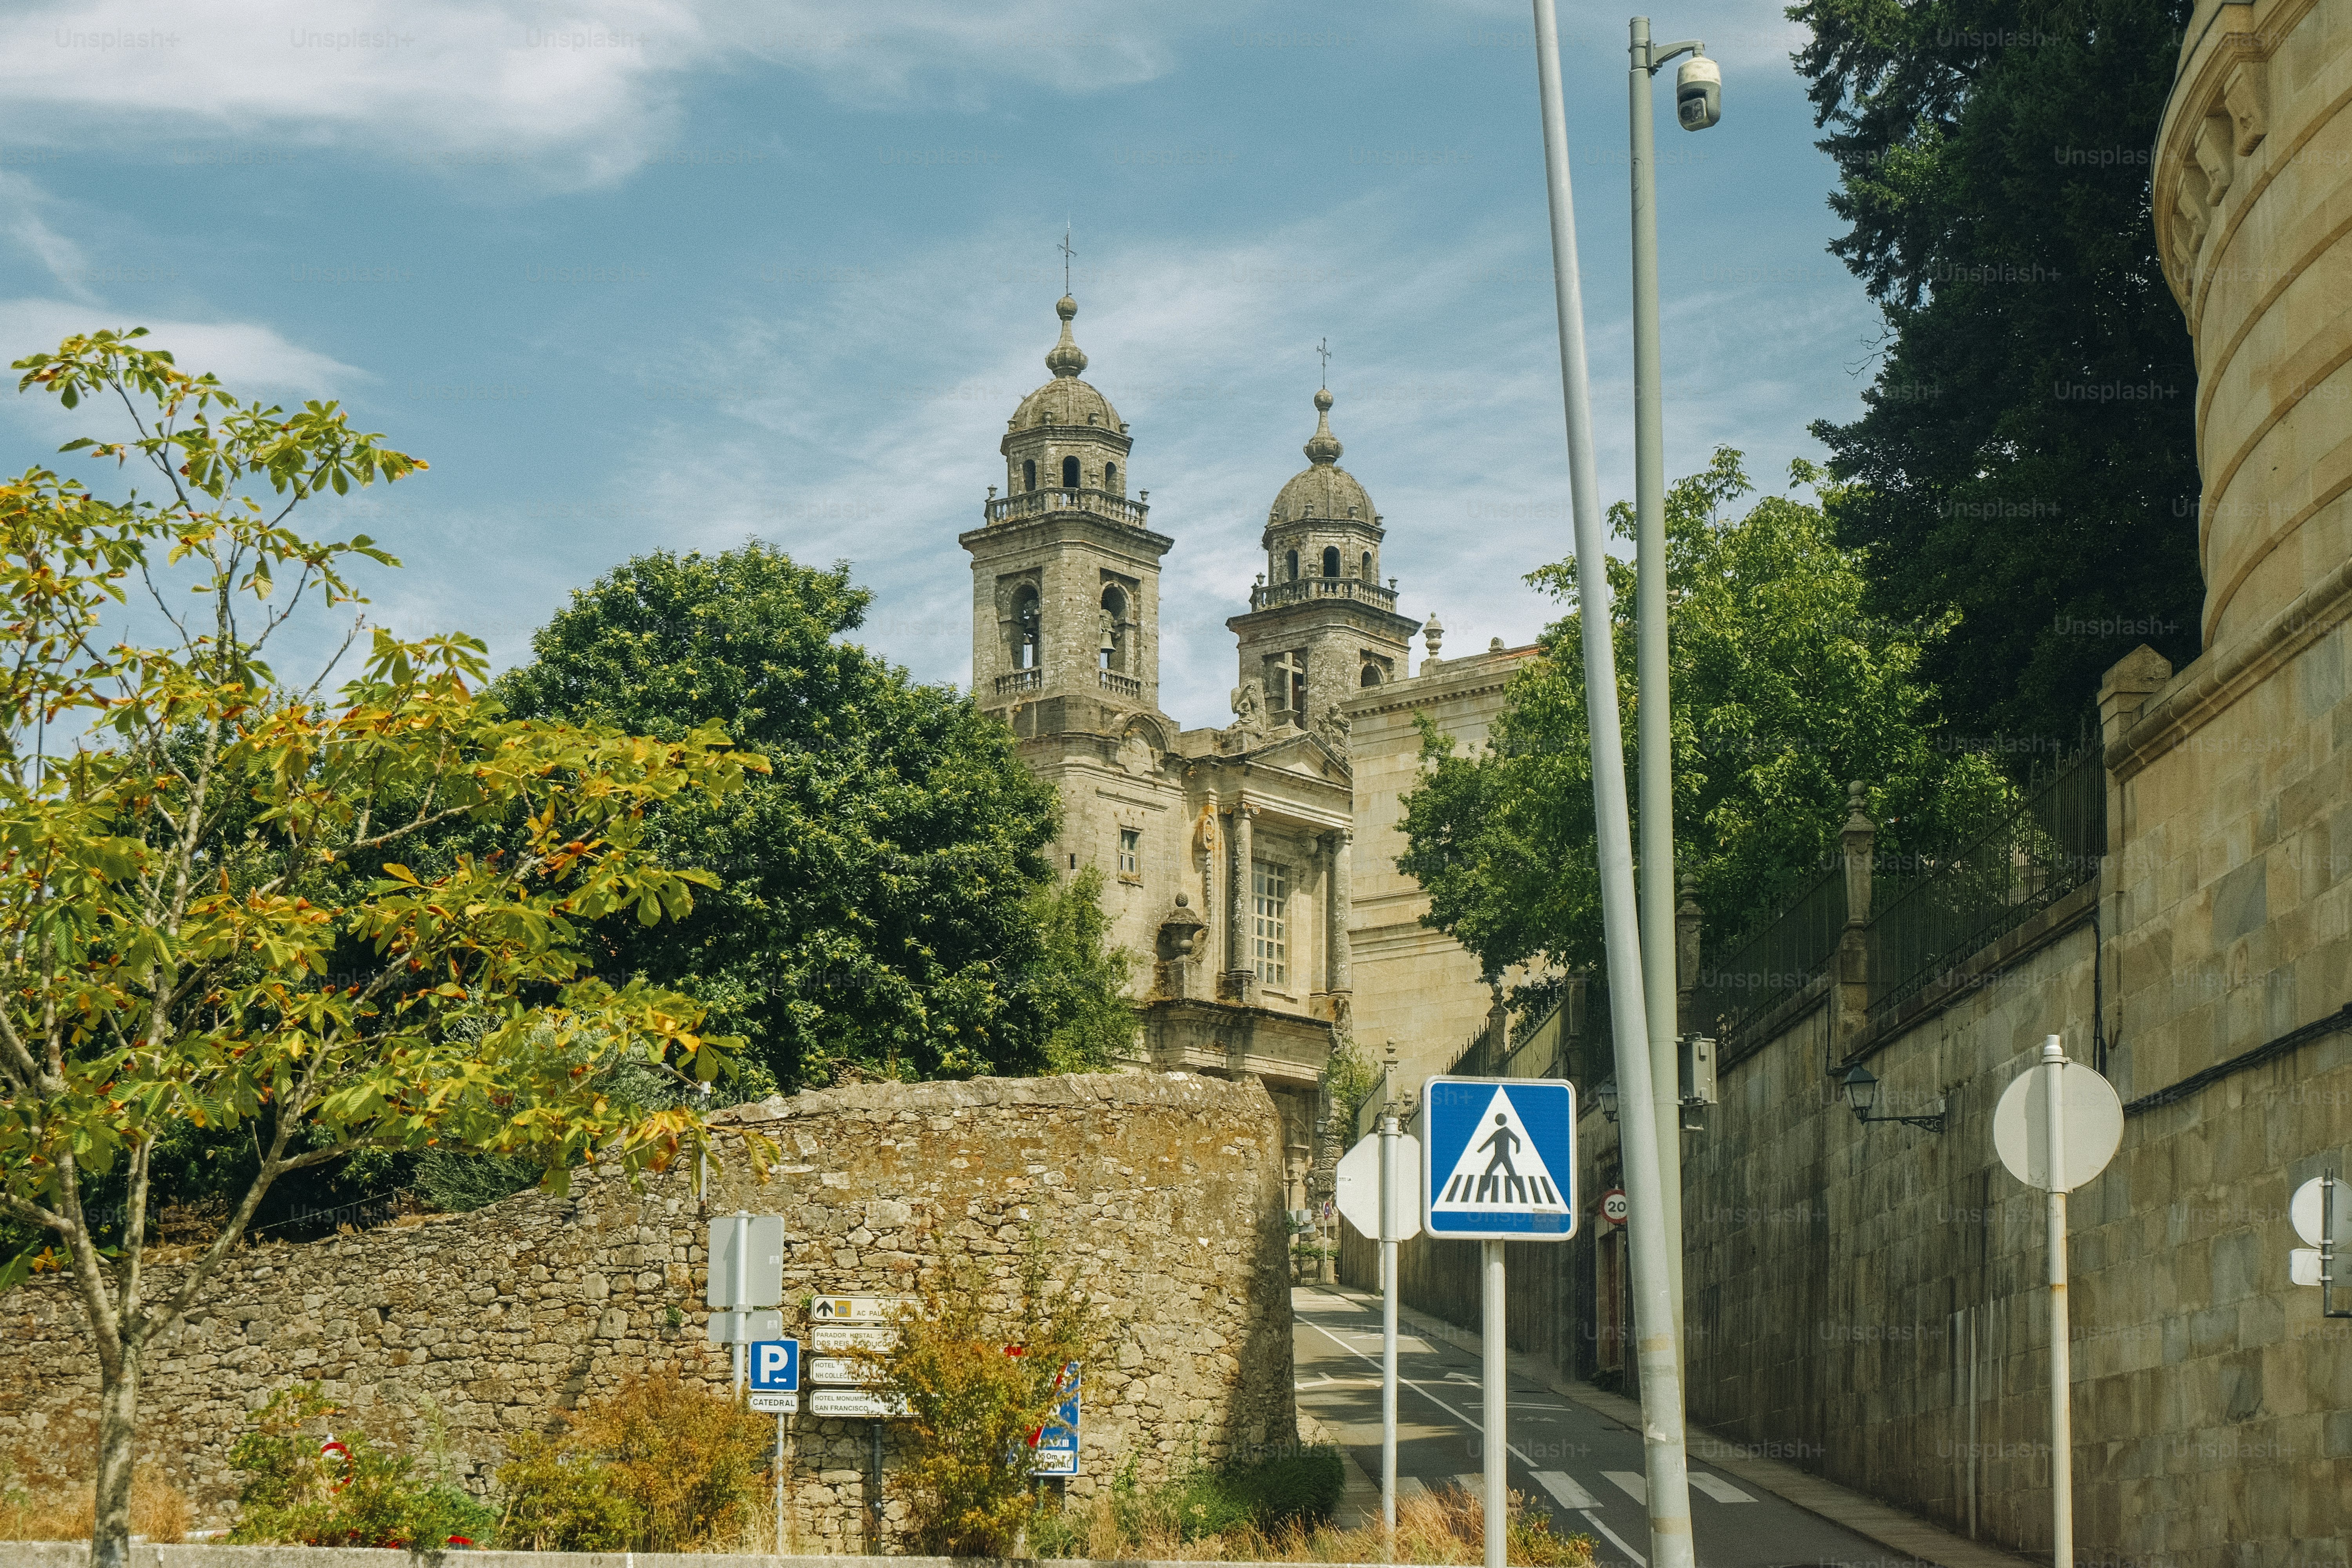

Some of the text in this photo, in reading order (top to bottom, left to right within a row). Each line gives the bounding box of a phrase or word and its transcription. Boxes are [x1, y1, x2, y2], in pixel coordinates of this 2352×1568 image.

[1608, 1201, 1626, 1212] 20
[760, 1345, 788, 1383] P
[753, 1398, 795, 1406] CATEDRAL
